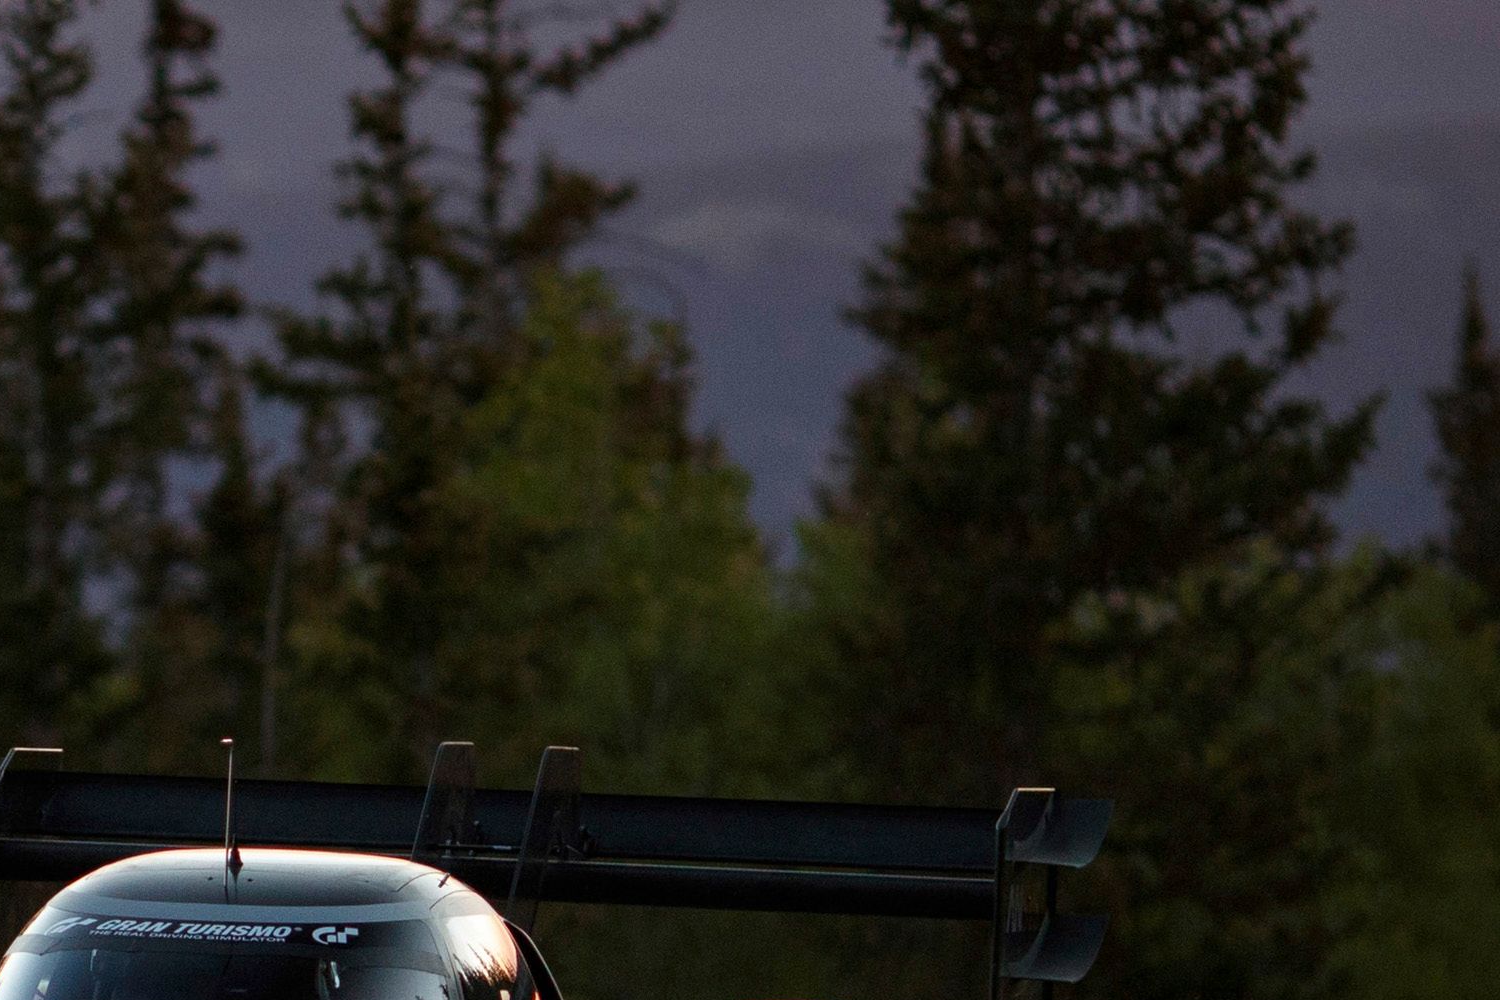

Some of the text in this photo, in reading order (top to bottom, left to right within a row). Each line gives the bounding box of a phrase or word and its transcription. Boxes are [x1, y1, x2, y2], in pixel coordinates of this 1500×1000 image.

[98, 919, 292, 938] GRAN TURISMO
[206, 935, 286, 943] SIMULATOR
